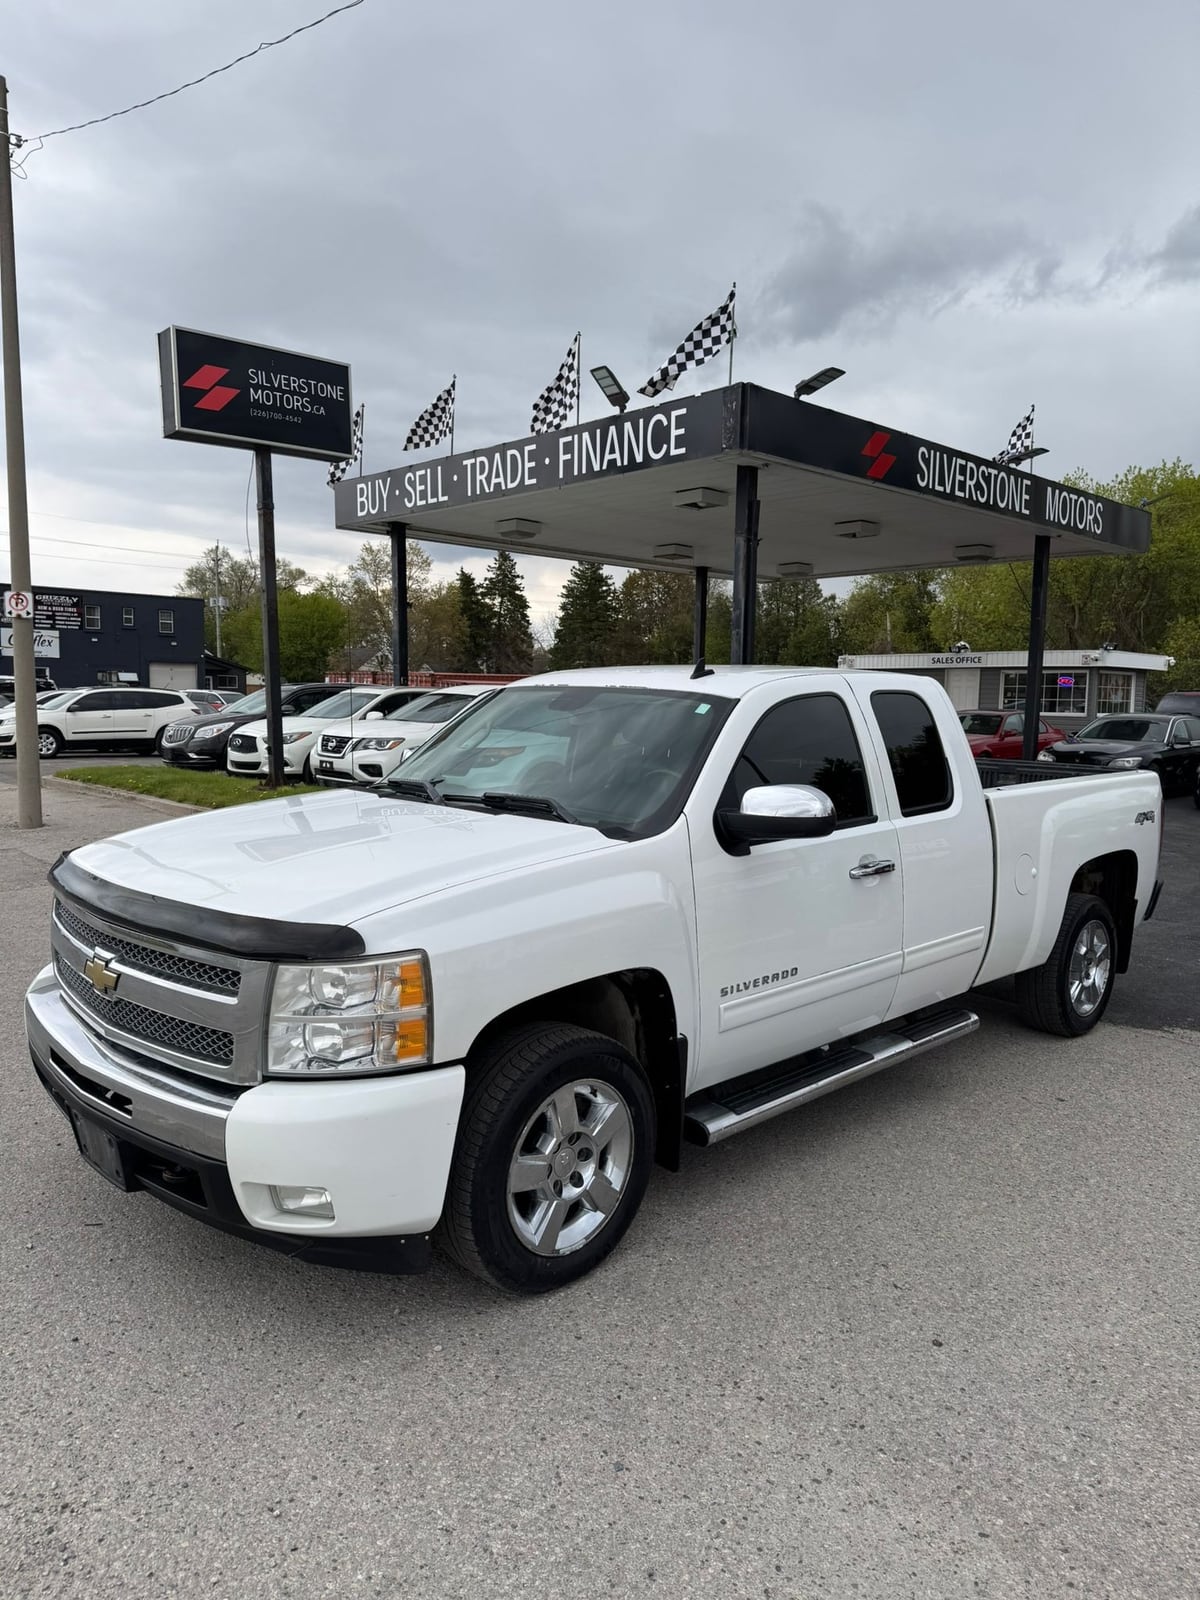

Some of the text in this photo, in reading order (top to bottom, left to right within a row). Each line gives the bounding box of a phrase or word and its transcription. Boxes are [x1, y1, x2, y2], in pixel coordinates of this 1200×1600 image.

[248, 368, 345, 401] SILVERSTONE
[356, 408, 687, 517] BUY SELL TRADE FINANCE
[916, 446, 1104, 535] SILVERSTONE MOTORS
[35, 594, 79, 603] GRIZZLY
[931, 656, 982, 665] SALES OFFICE
[720, 966, 799, 998] SILVERADO
